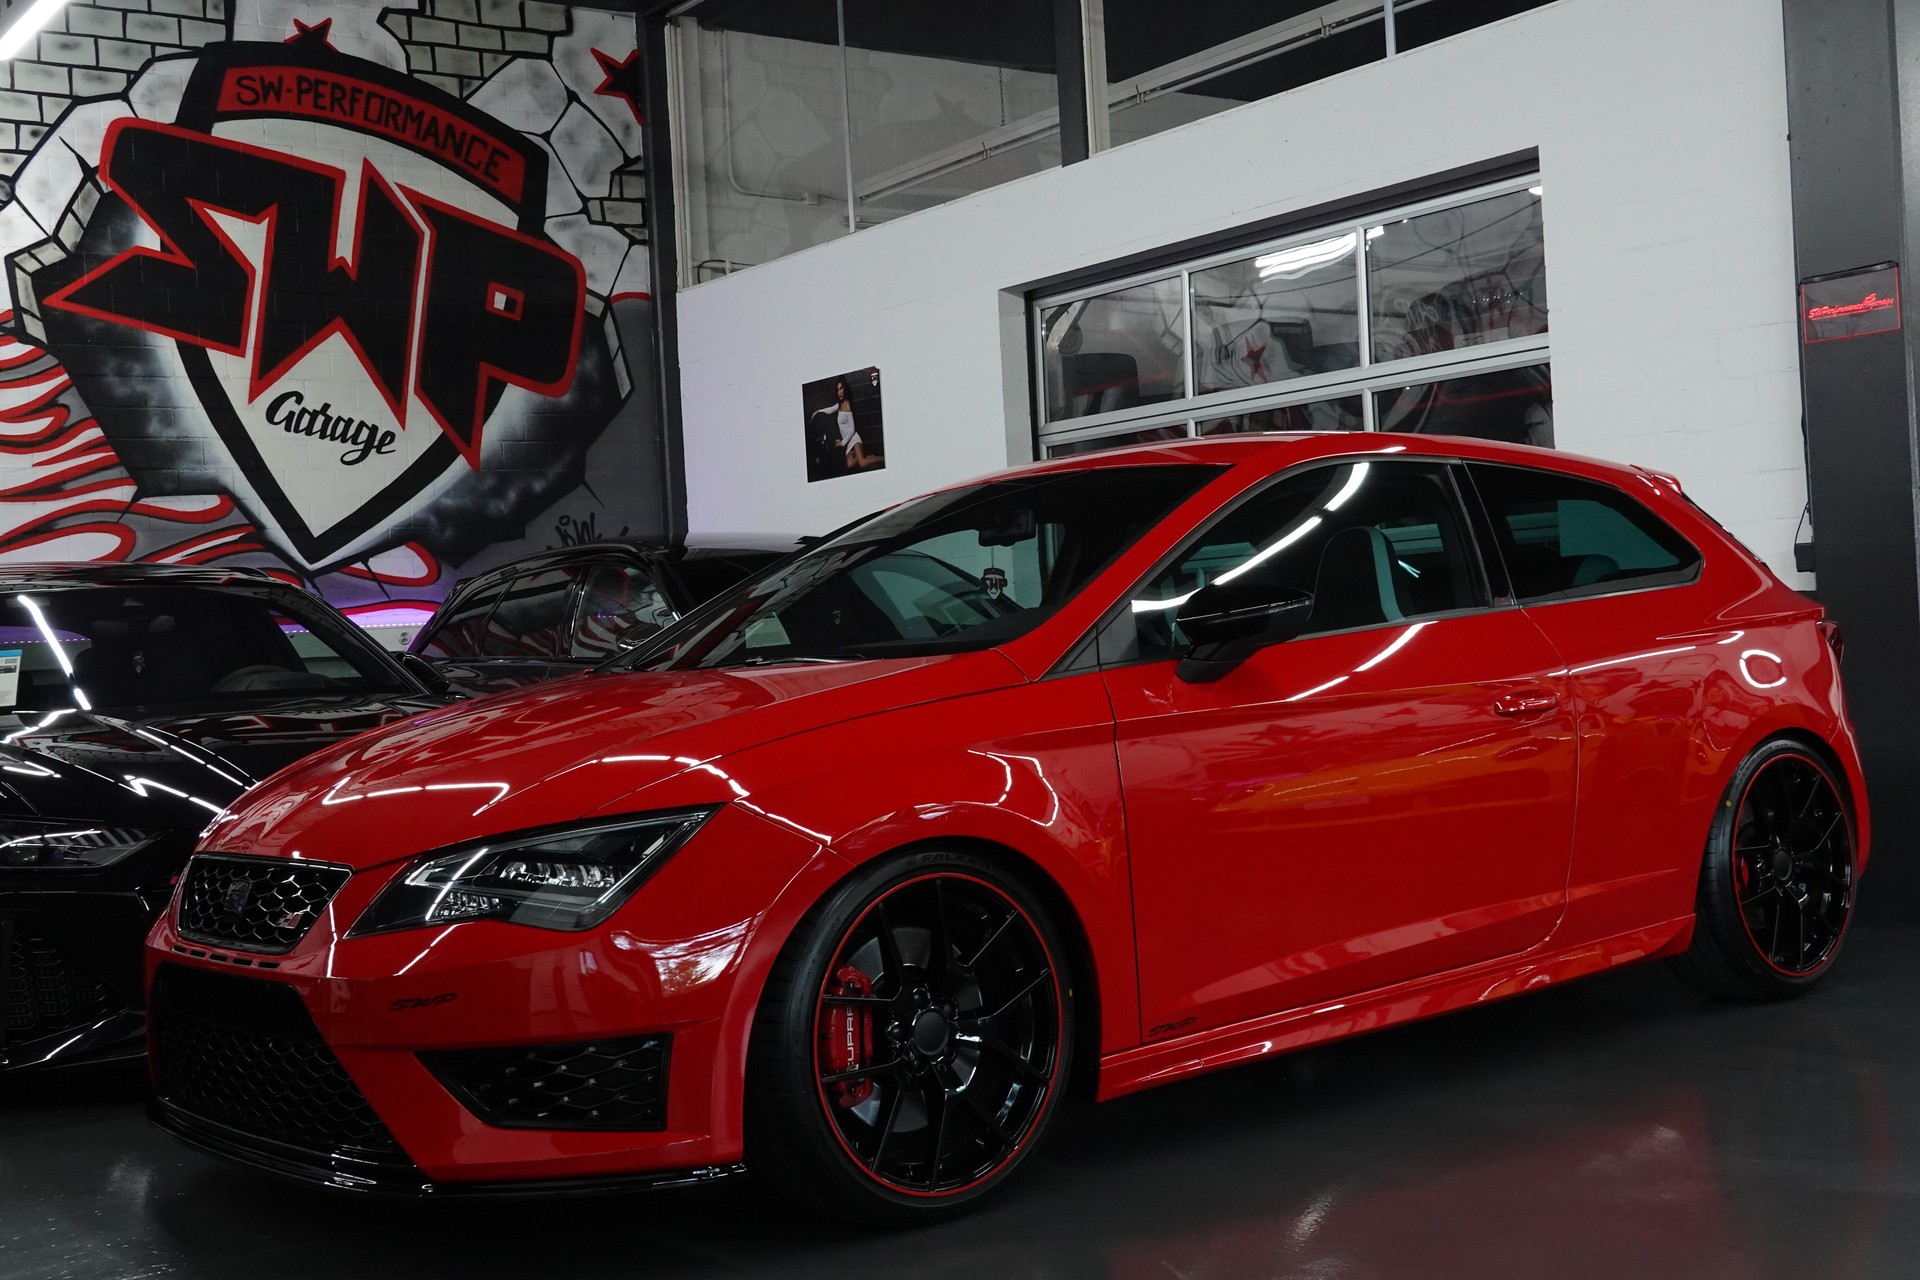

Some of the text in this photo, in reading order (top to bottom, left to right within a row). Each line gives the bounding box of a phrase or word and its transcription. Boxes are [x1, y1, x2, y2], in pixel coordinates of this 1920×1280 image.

[235, 74, 511, 183] SW-PERFORMANCE
[43, 116, 587, 474] SWP
[265, 390, 397, 466] Garage
[389, 993, 458, 1011] SWP
[1148, 1016, 1197, 1036] SWP
